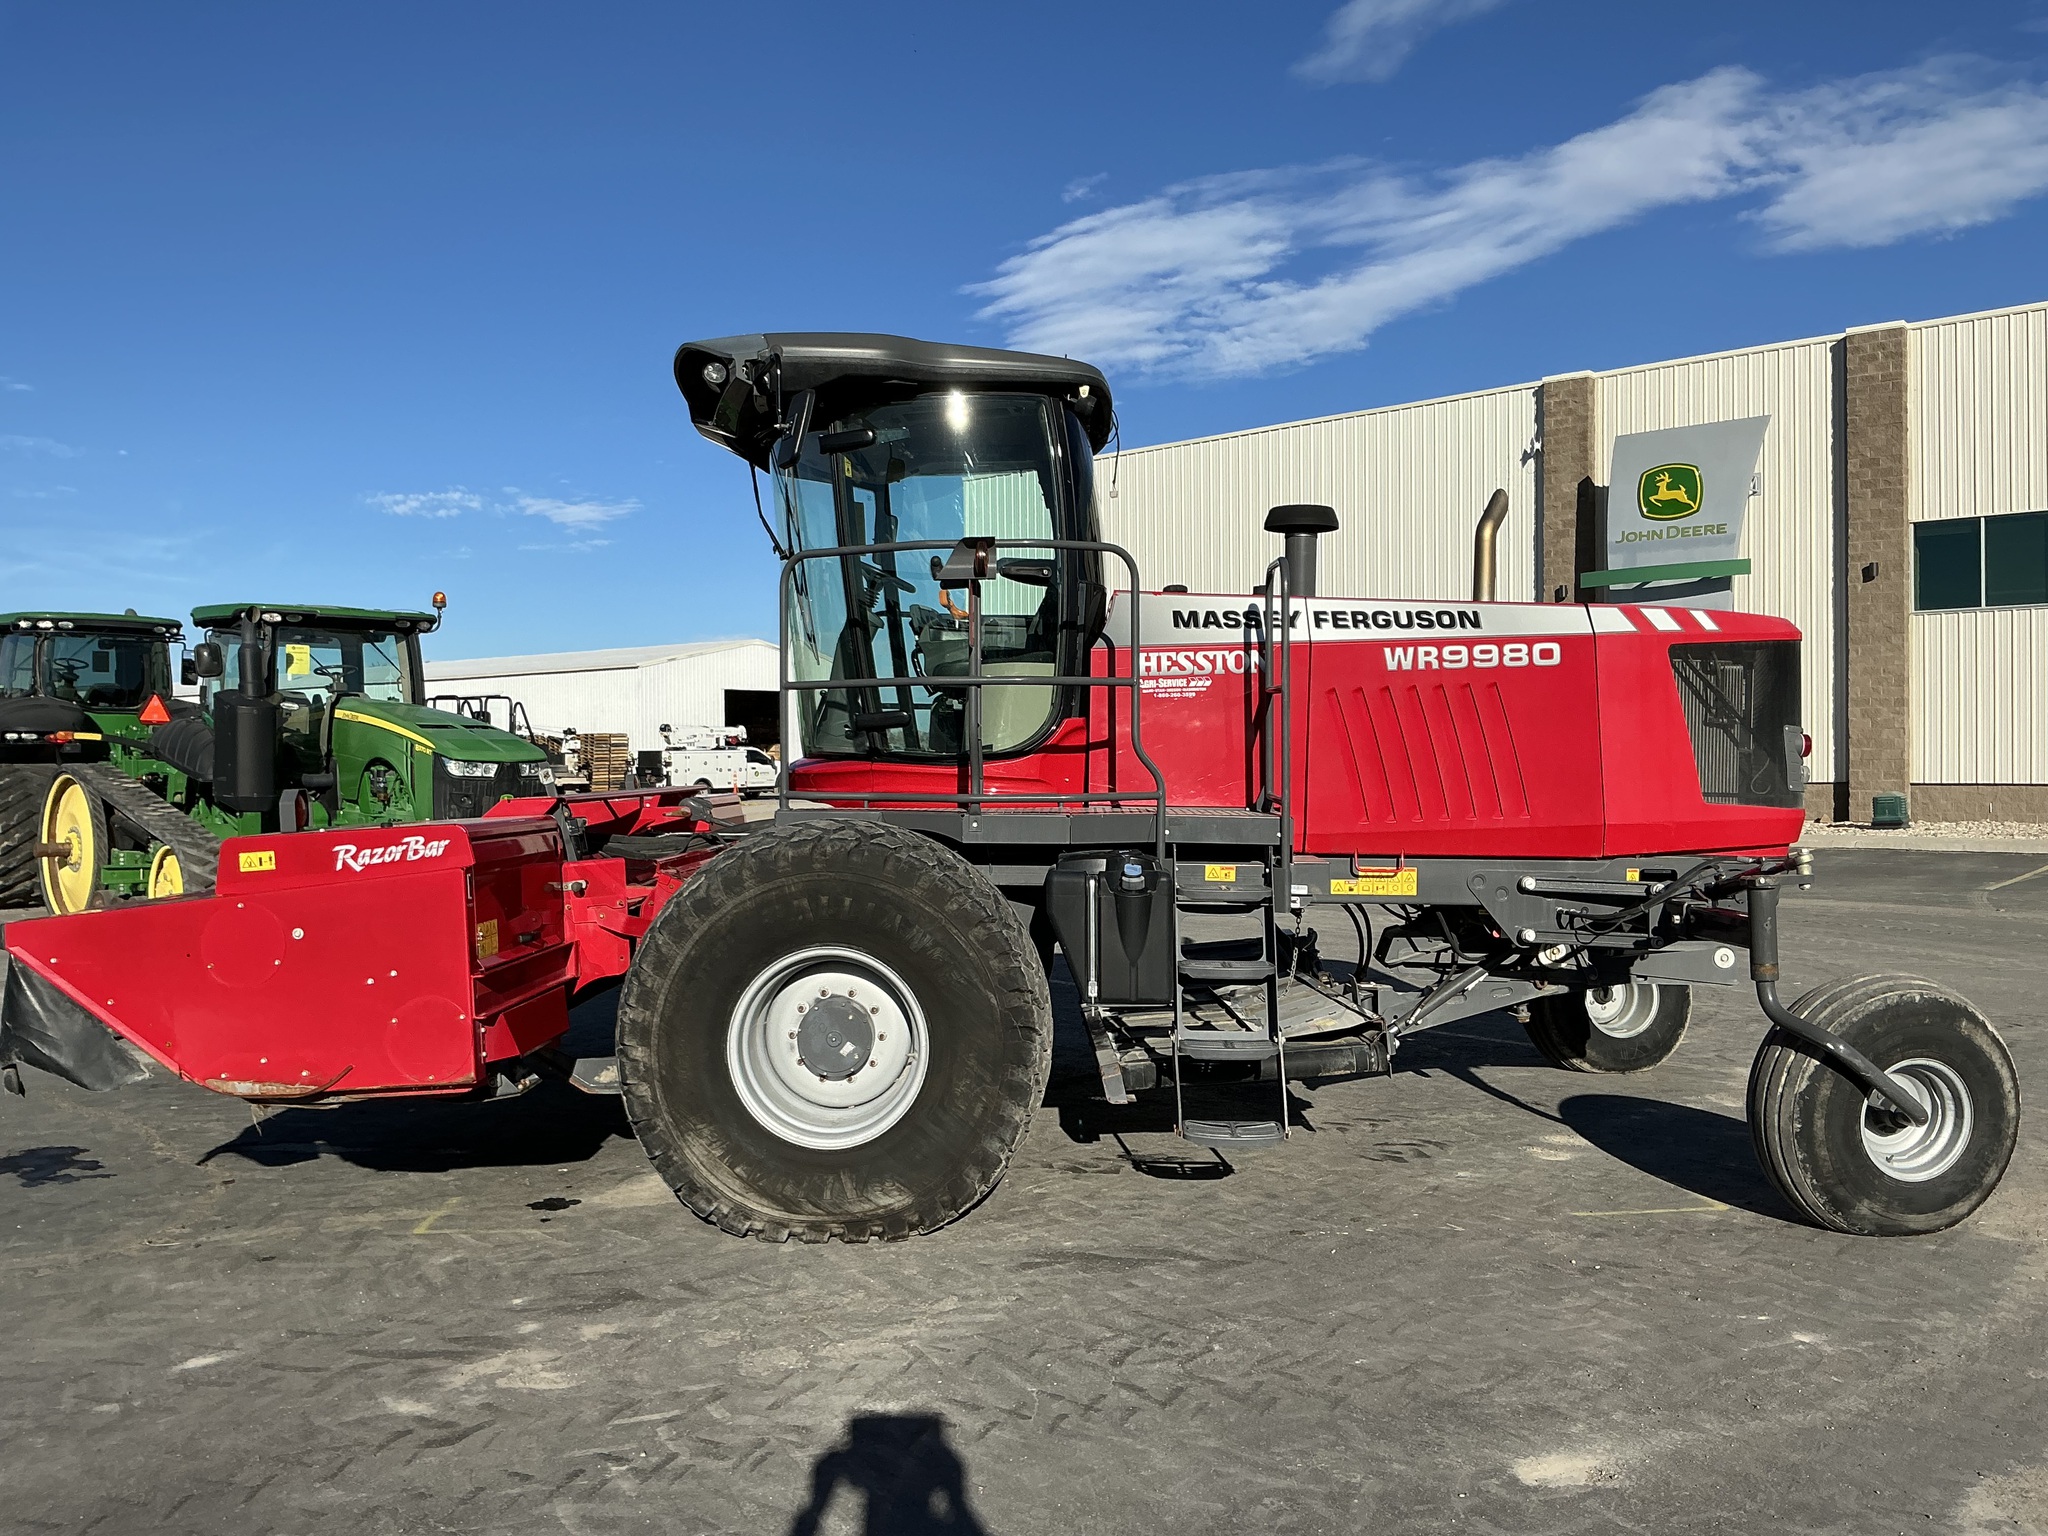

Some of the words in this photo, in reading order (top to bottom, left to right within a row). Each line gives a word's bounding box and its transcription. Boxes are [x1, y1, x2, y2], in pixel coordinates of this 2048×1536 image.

[1615, 529, 1664, 544] JOHN
[1665, 523, 1728, 540] DEERE
[1172, 610, 1302, 629] MASSEY
[1313, 610, 1483, 629] FERGUSON
[1138, 650, 1266, 676] HESSTON
[1383, 642, 1562, 671] WR9980
[332, 835, 451, 872] RazorBar
